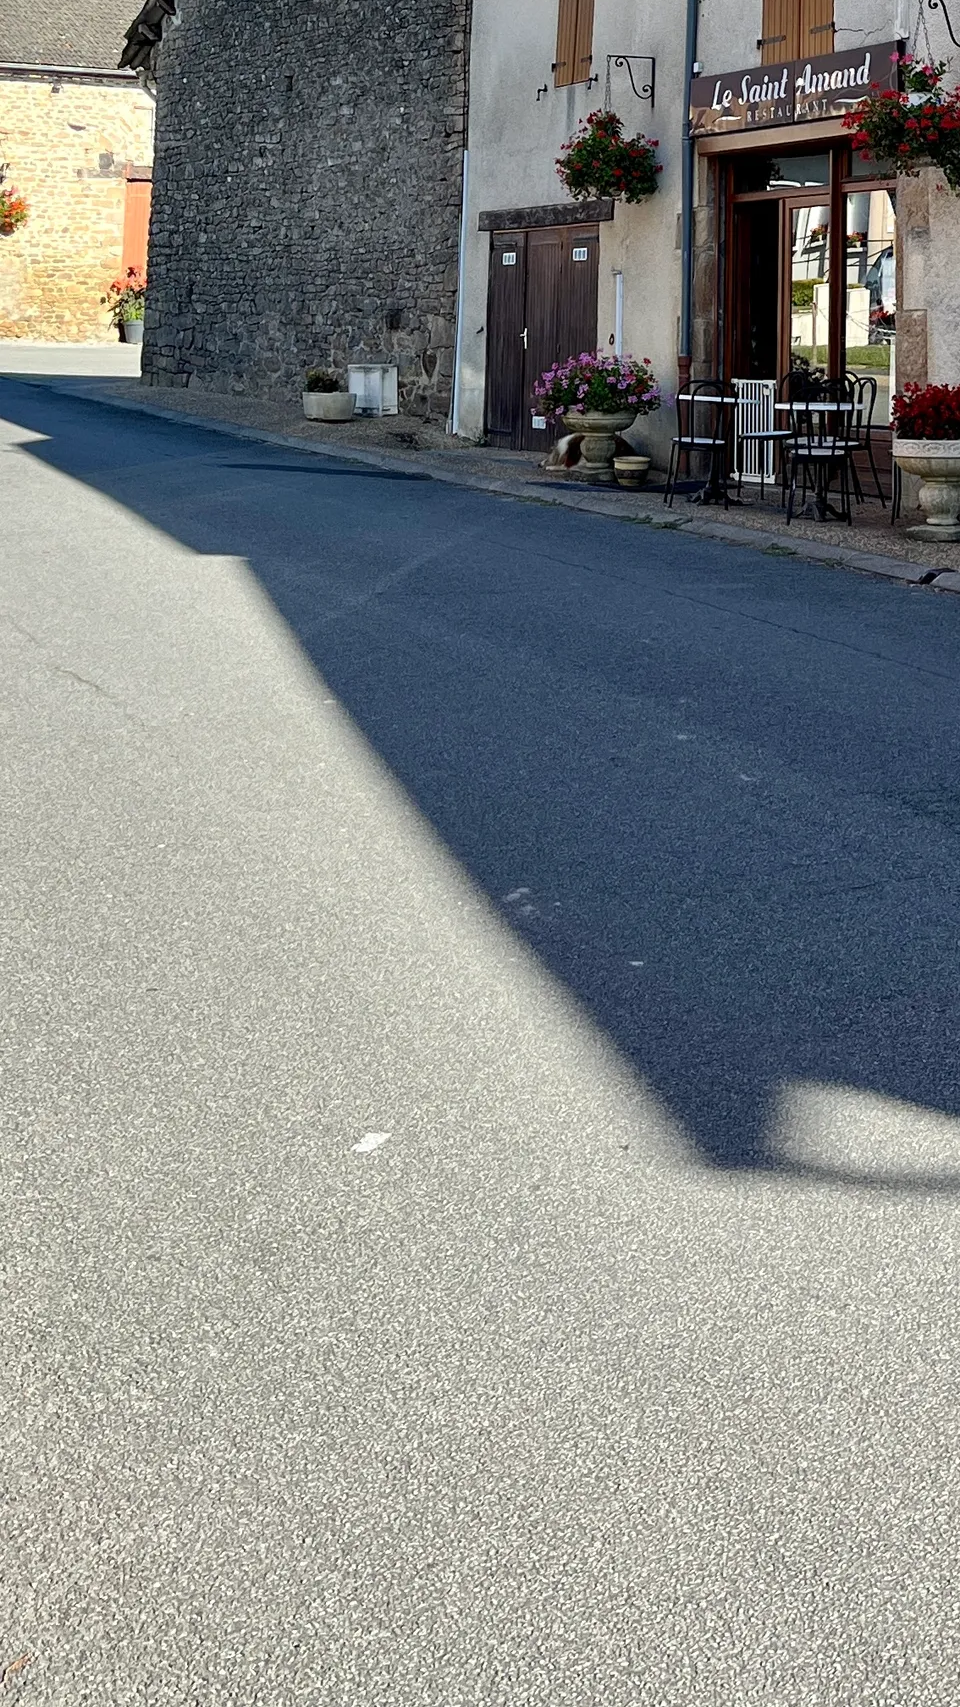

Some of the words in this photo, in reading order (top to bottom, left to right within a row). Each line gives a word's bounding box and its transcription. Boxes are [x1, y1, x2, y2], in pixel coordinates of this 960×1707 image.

[711, 80, 732, 110] Le
[738, 68, 788, 105] Saint
[795, 52, 871, 95] Amand
[746, 98, 828, 123] RESTAURANT
